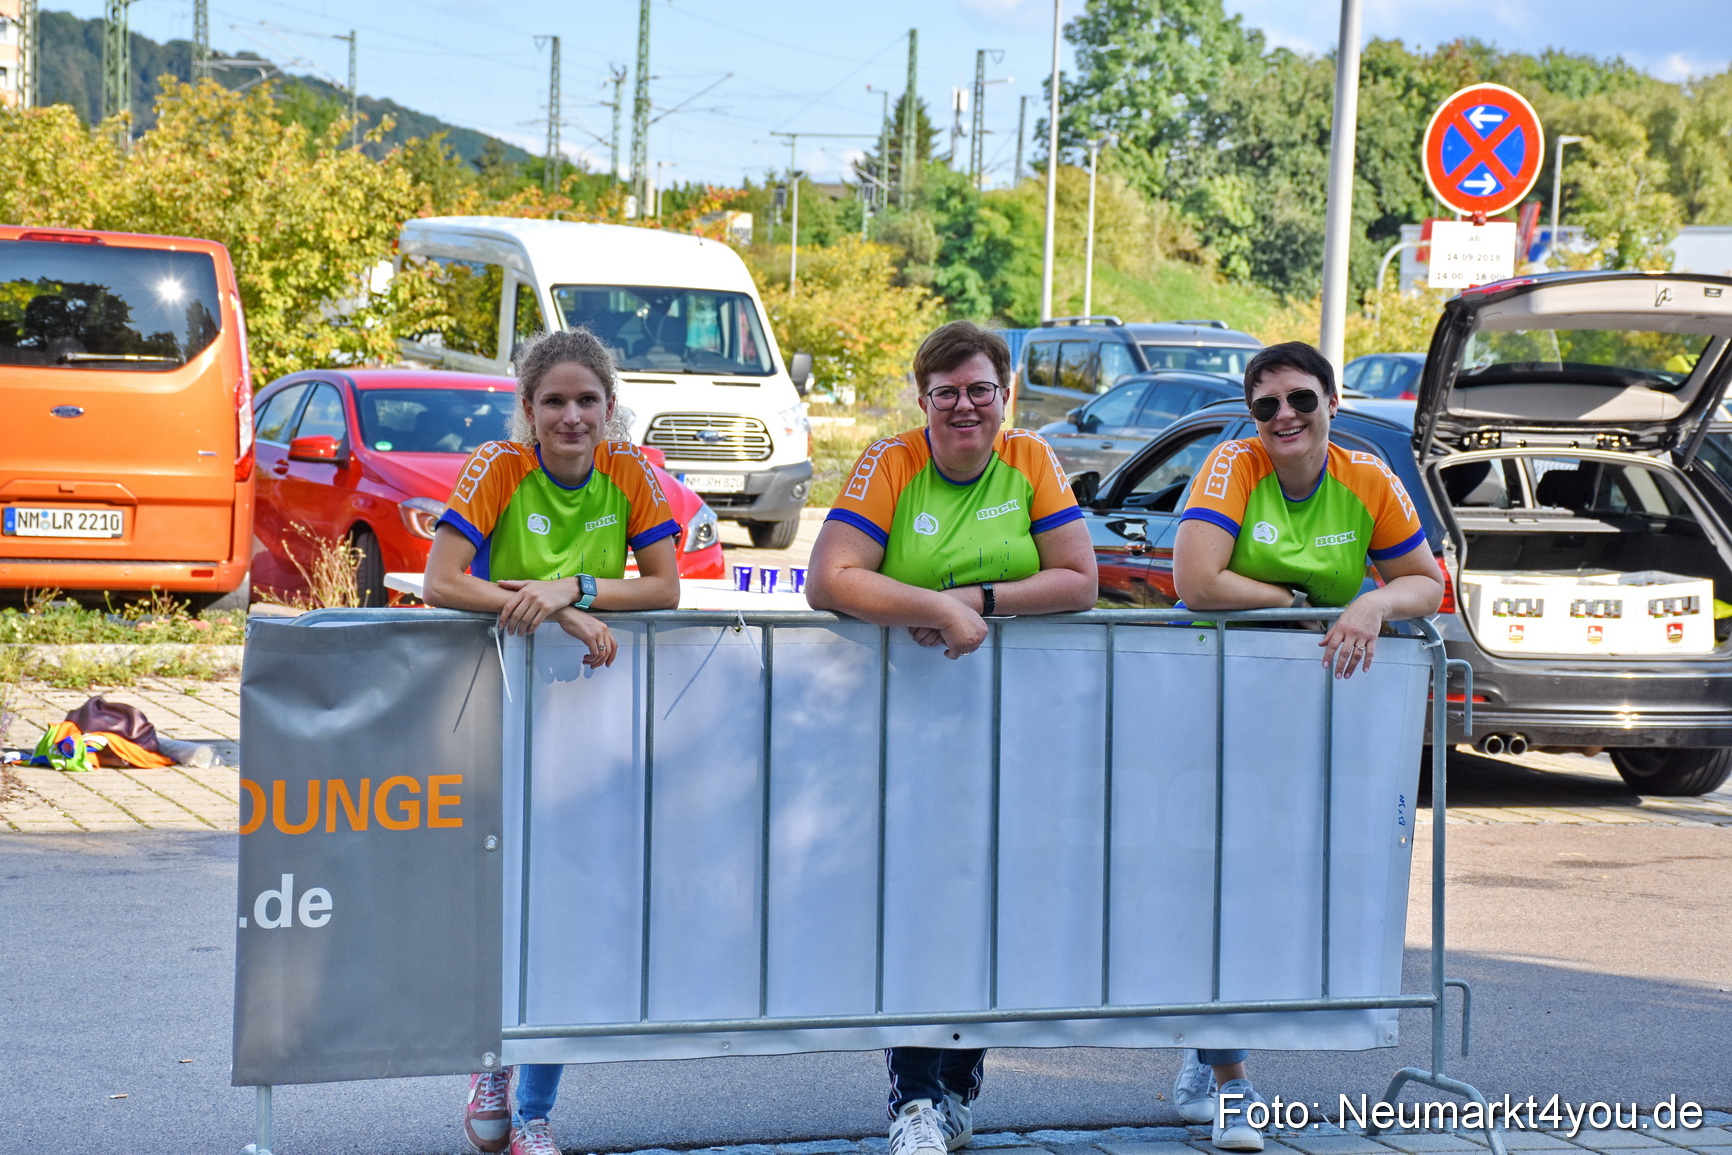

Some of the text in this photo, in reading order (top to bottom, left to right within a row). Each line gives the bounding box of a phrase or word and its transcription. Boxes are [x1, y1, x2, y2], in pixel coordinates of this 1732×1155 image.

[976, 499, 1020, 520] BOCK
[18, 511, 39, 529] NM
[52, 512, 73, 530] LR
[78, 513, 120, 531] 2210
[1315, 530, 1357, 547] BOCK
[239, 873, 333, 930] .de
